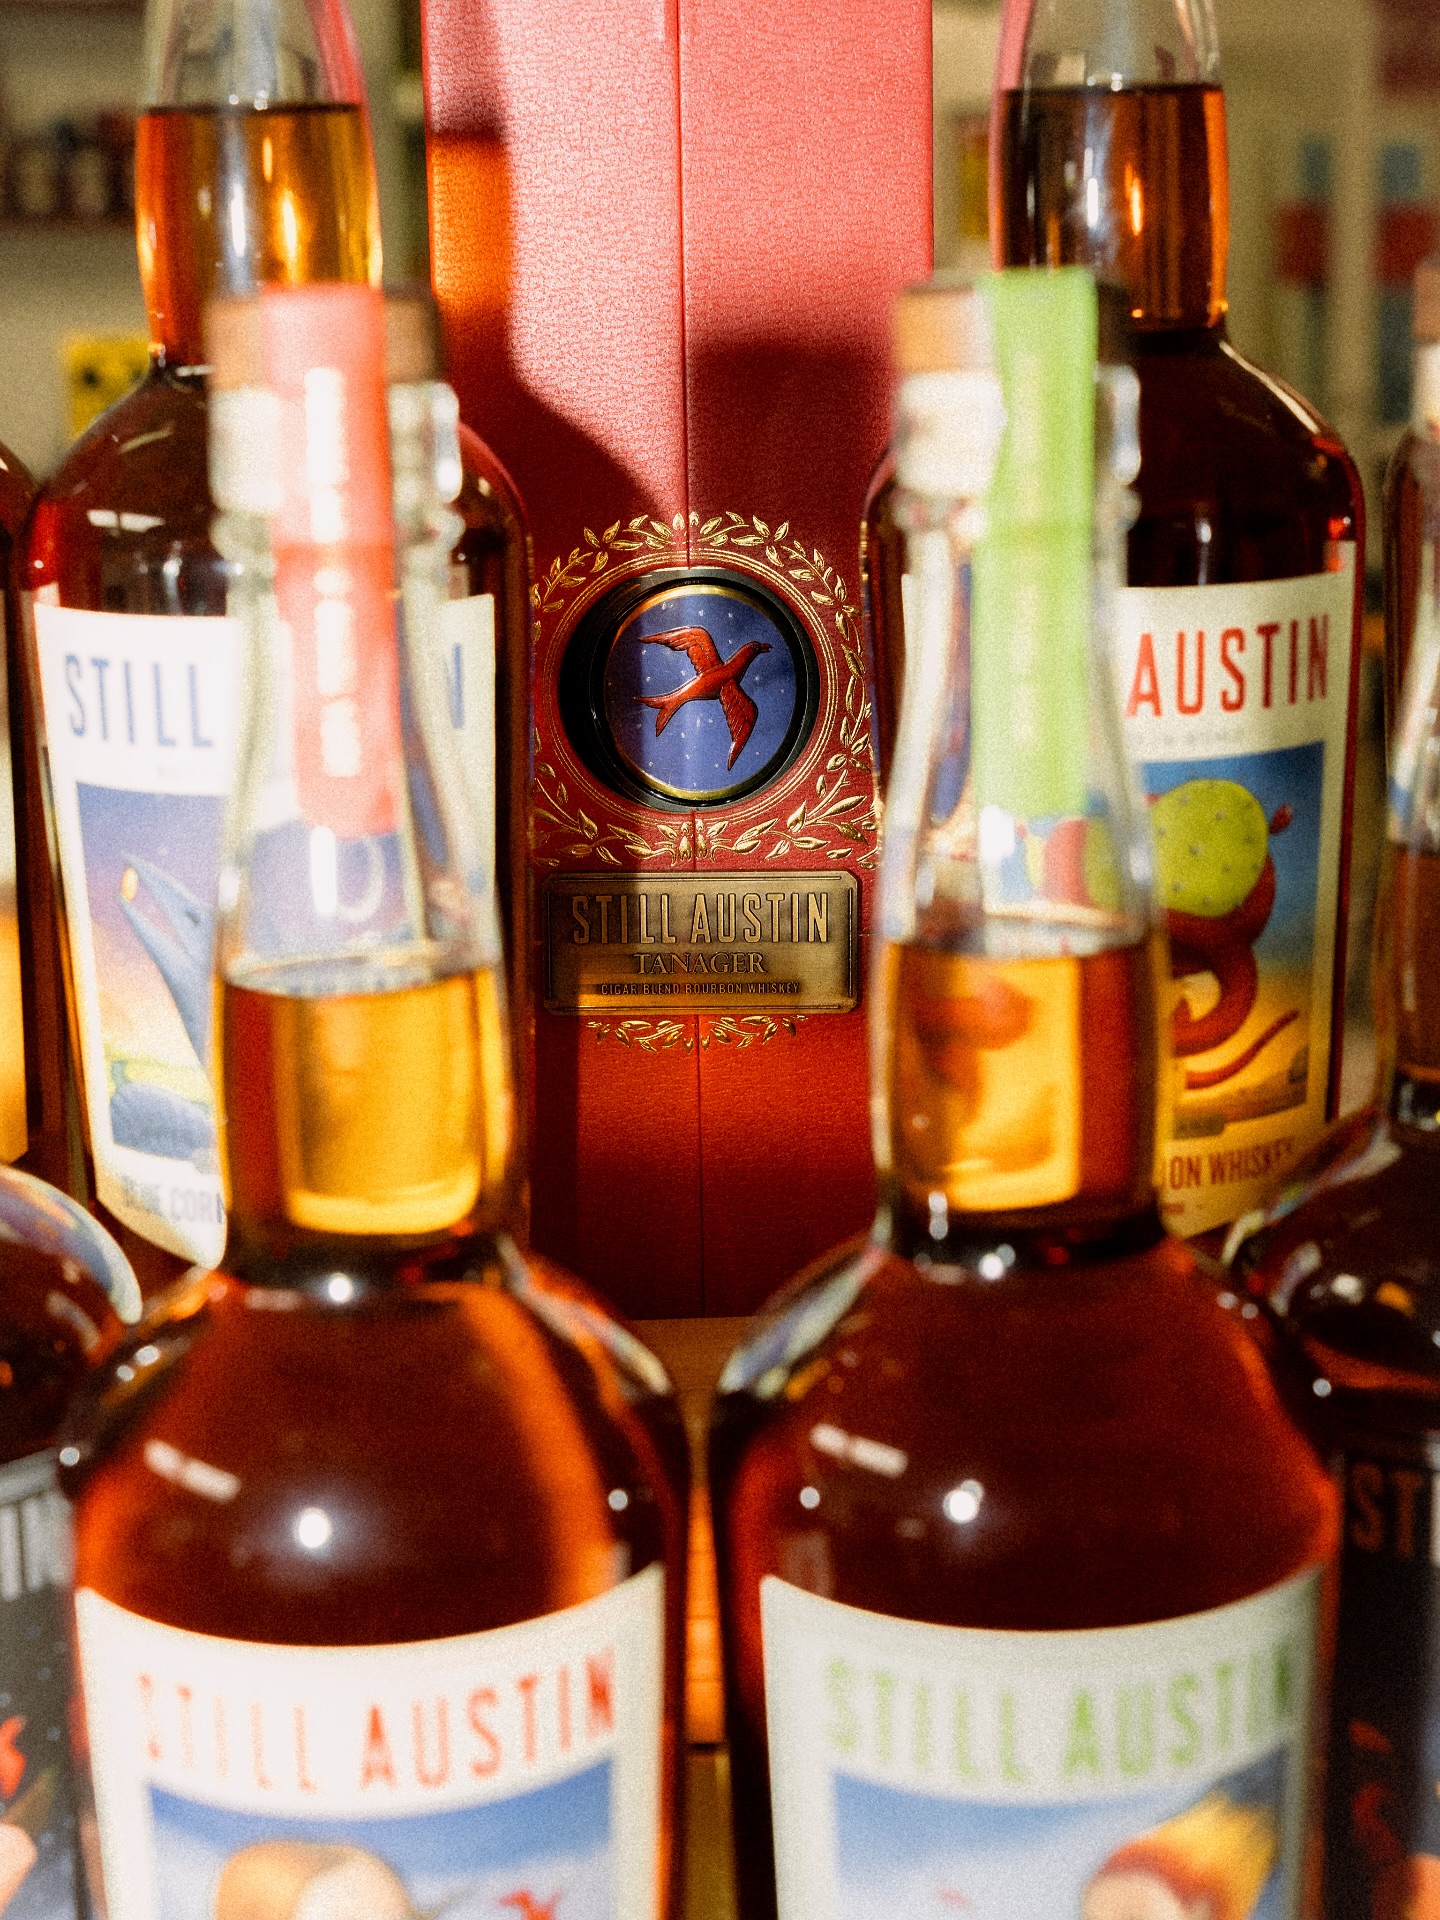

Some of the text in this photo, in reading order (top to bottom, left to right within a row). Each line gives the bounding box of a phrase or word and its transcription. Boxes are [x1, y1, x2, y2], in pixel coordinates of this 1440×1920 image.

[64, 653, 215, 749] STILL
[1126, 613, 1329, 717] AUSTIN
[572, 892, 829, 945] STILL AUSTIN
[633, 952, 768, 975] TANAGER
[601, 981, 800, 996] CIGAR BLEND BOURBON WHISKEY
[138, 1646, 617, 1793] STILL AUSTIN
[823, 1636, 1295, 1784] STILL AUSTIN
